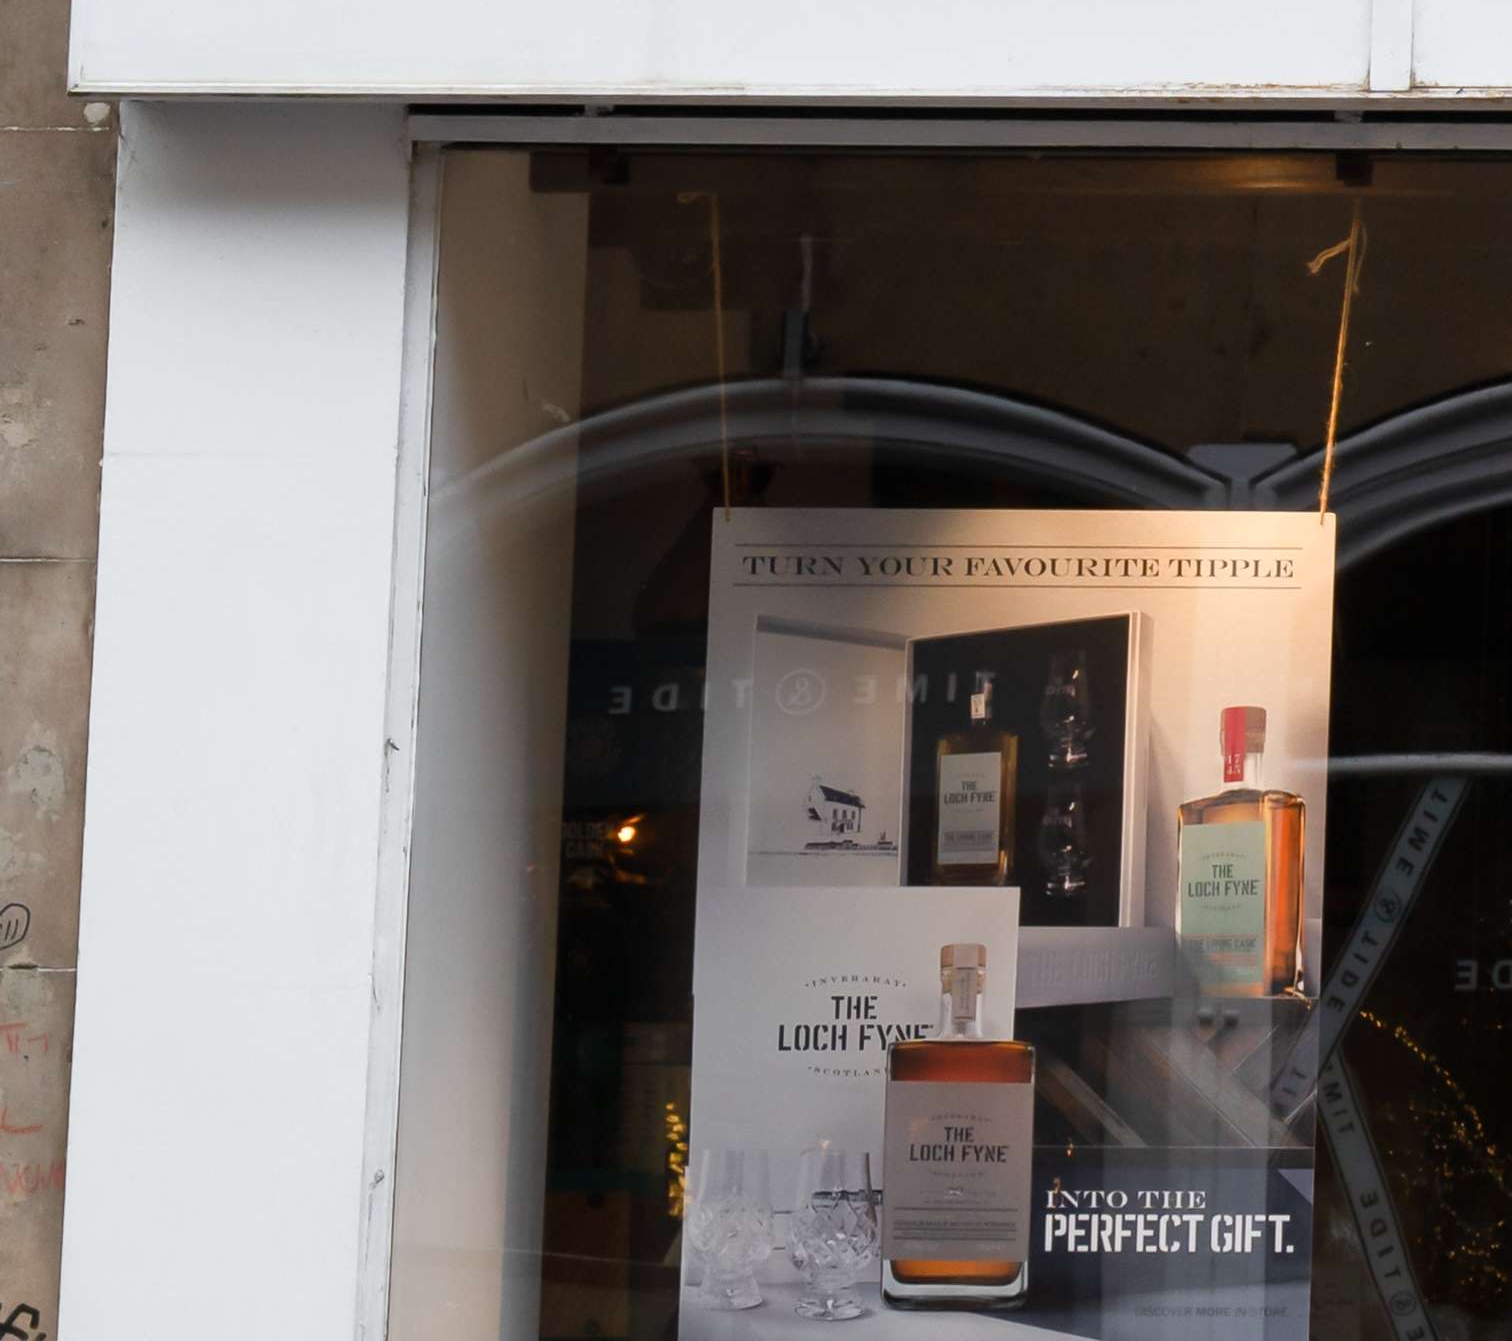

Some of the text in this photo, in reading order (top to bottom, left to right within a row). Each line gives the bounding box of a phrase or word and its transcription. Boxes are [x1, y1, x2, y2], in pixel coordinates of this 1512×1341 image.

[743, 556, 1296, 579] TURN YOUR FAVOURITE TIPPLE
[1211, 864, 1234, 878] THE
[1188, 880, 1259, 897] LOCH FYNE
[831, 996, 878, 1020] THE
[778, 1024, 847, 1051] LOCH
[944, 1127, 974, 1142] THE
[910, 1145, 1008, 1162] LOCH FYNE
[1045, 1190, 1207, 1209] INTO THE
[1044, 1214, 1295, 1254] PERFECT GIFT.
